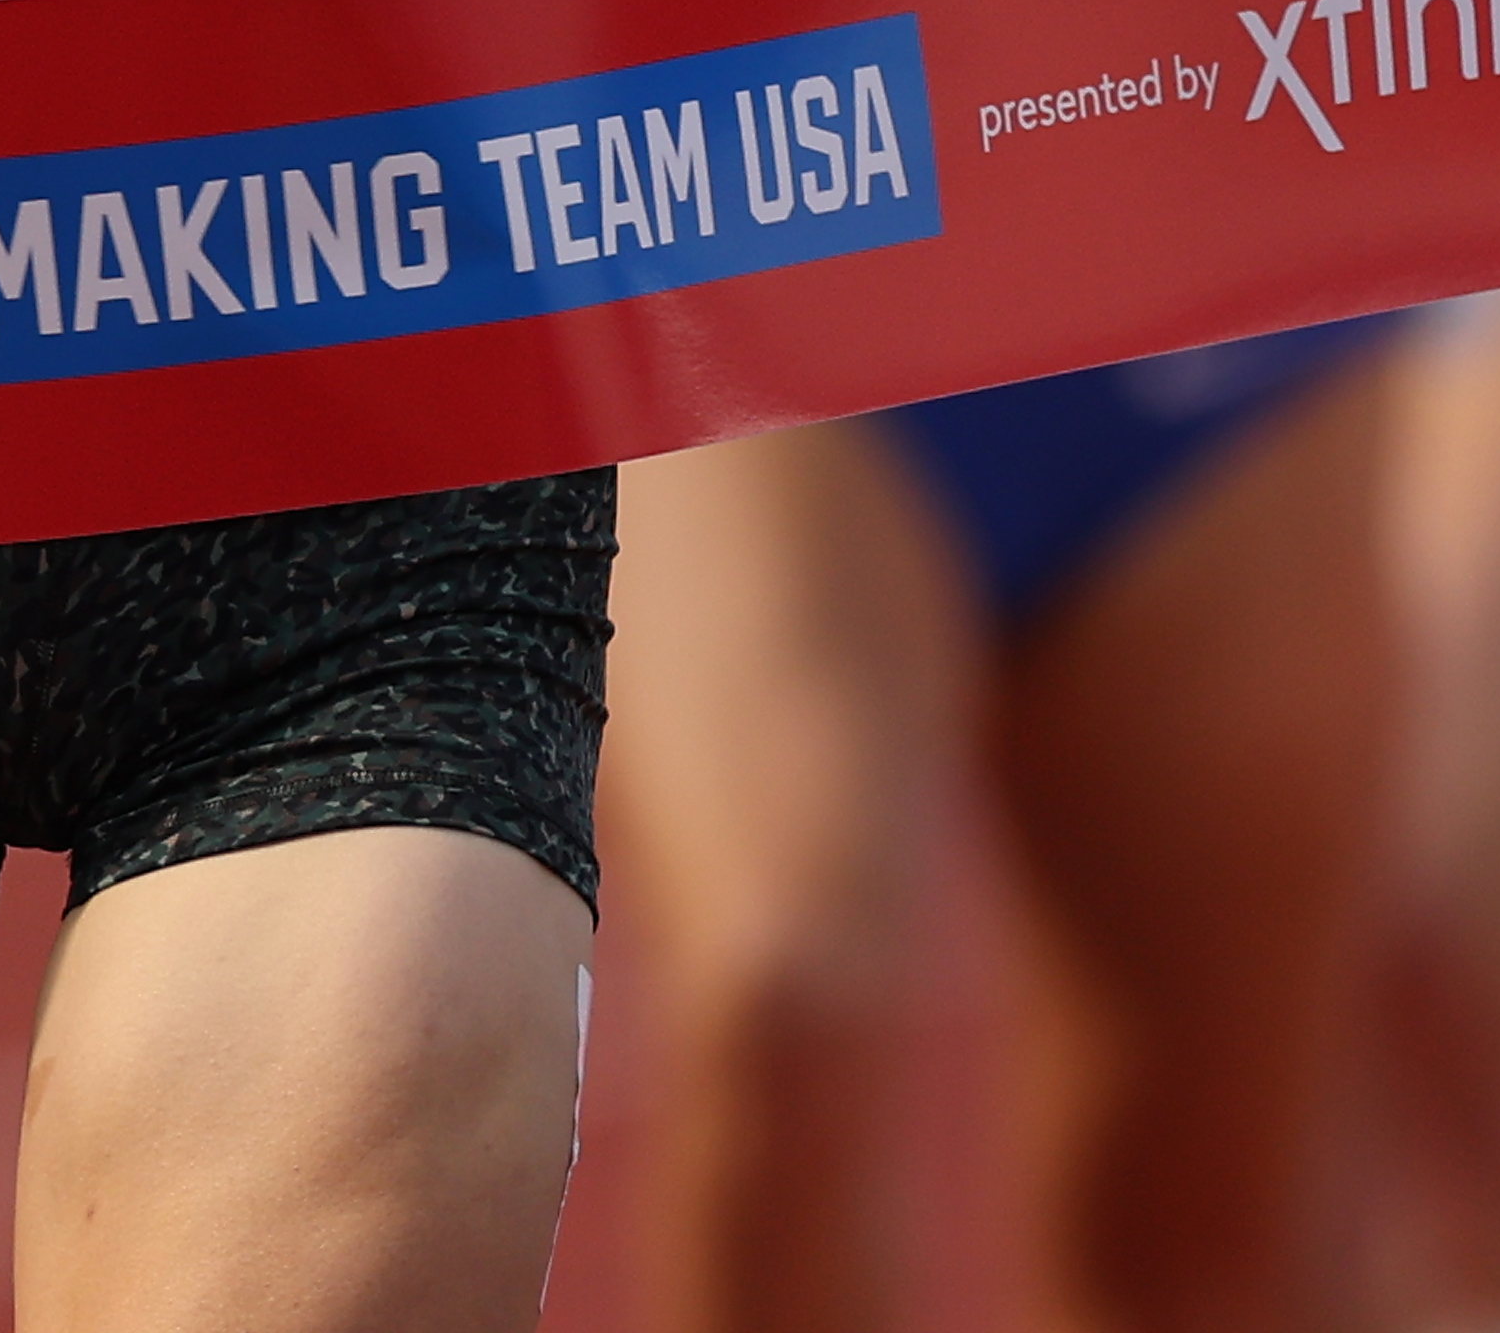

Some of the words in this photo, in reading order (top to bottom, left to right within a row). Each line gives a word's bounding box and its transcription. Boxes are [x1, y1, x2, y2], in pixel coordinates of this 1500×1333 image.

[477, 99, 716, 274] TEAM
[732, 63, 910, 228] USA
[978, 57, 1164, 154] presented
[1173, 53, 1221, 112] by
